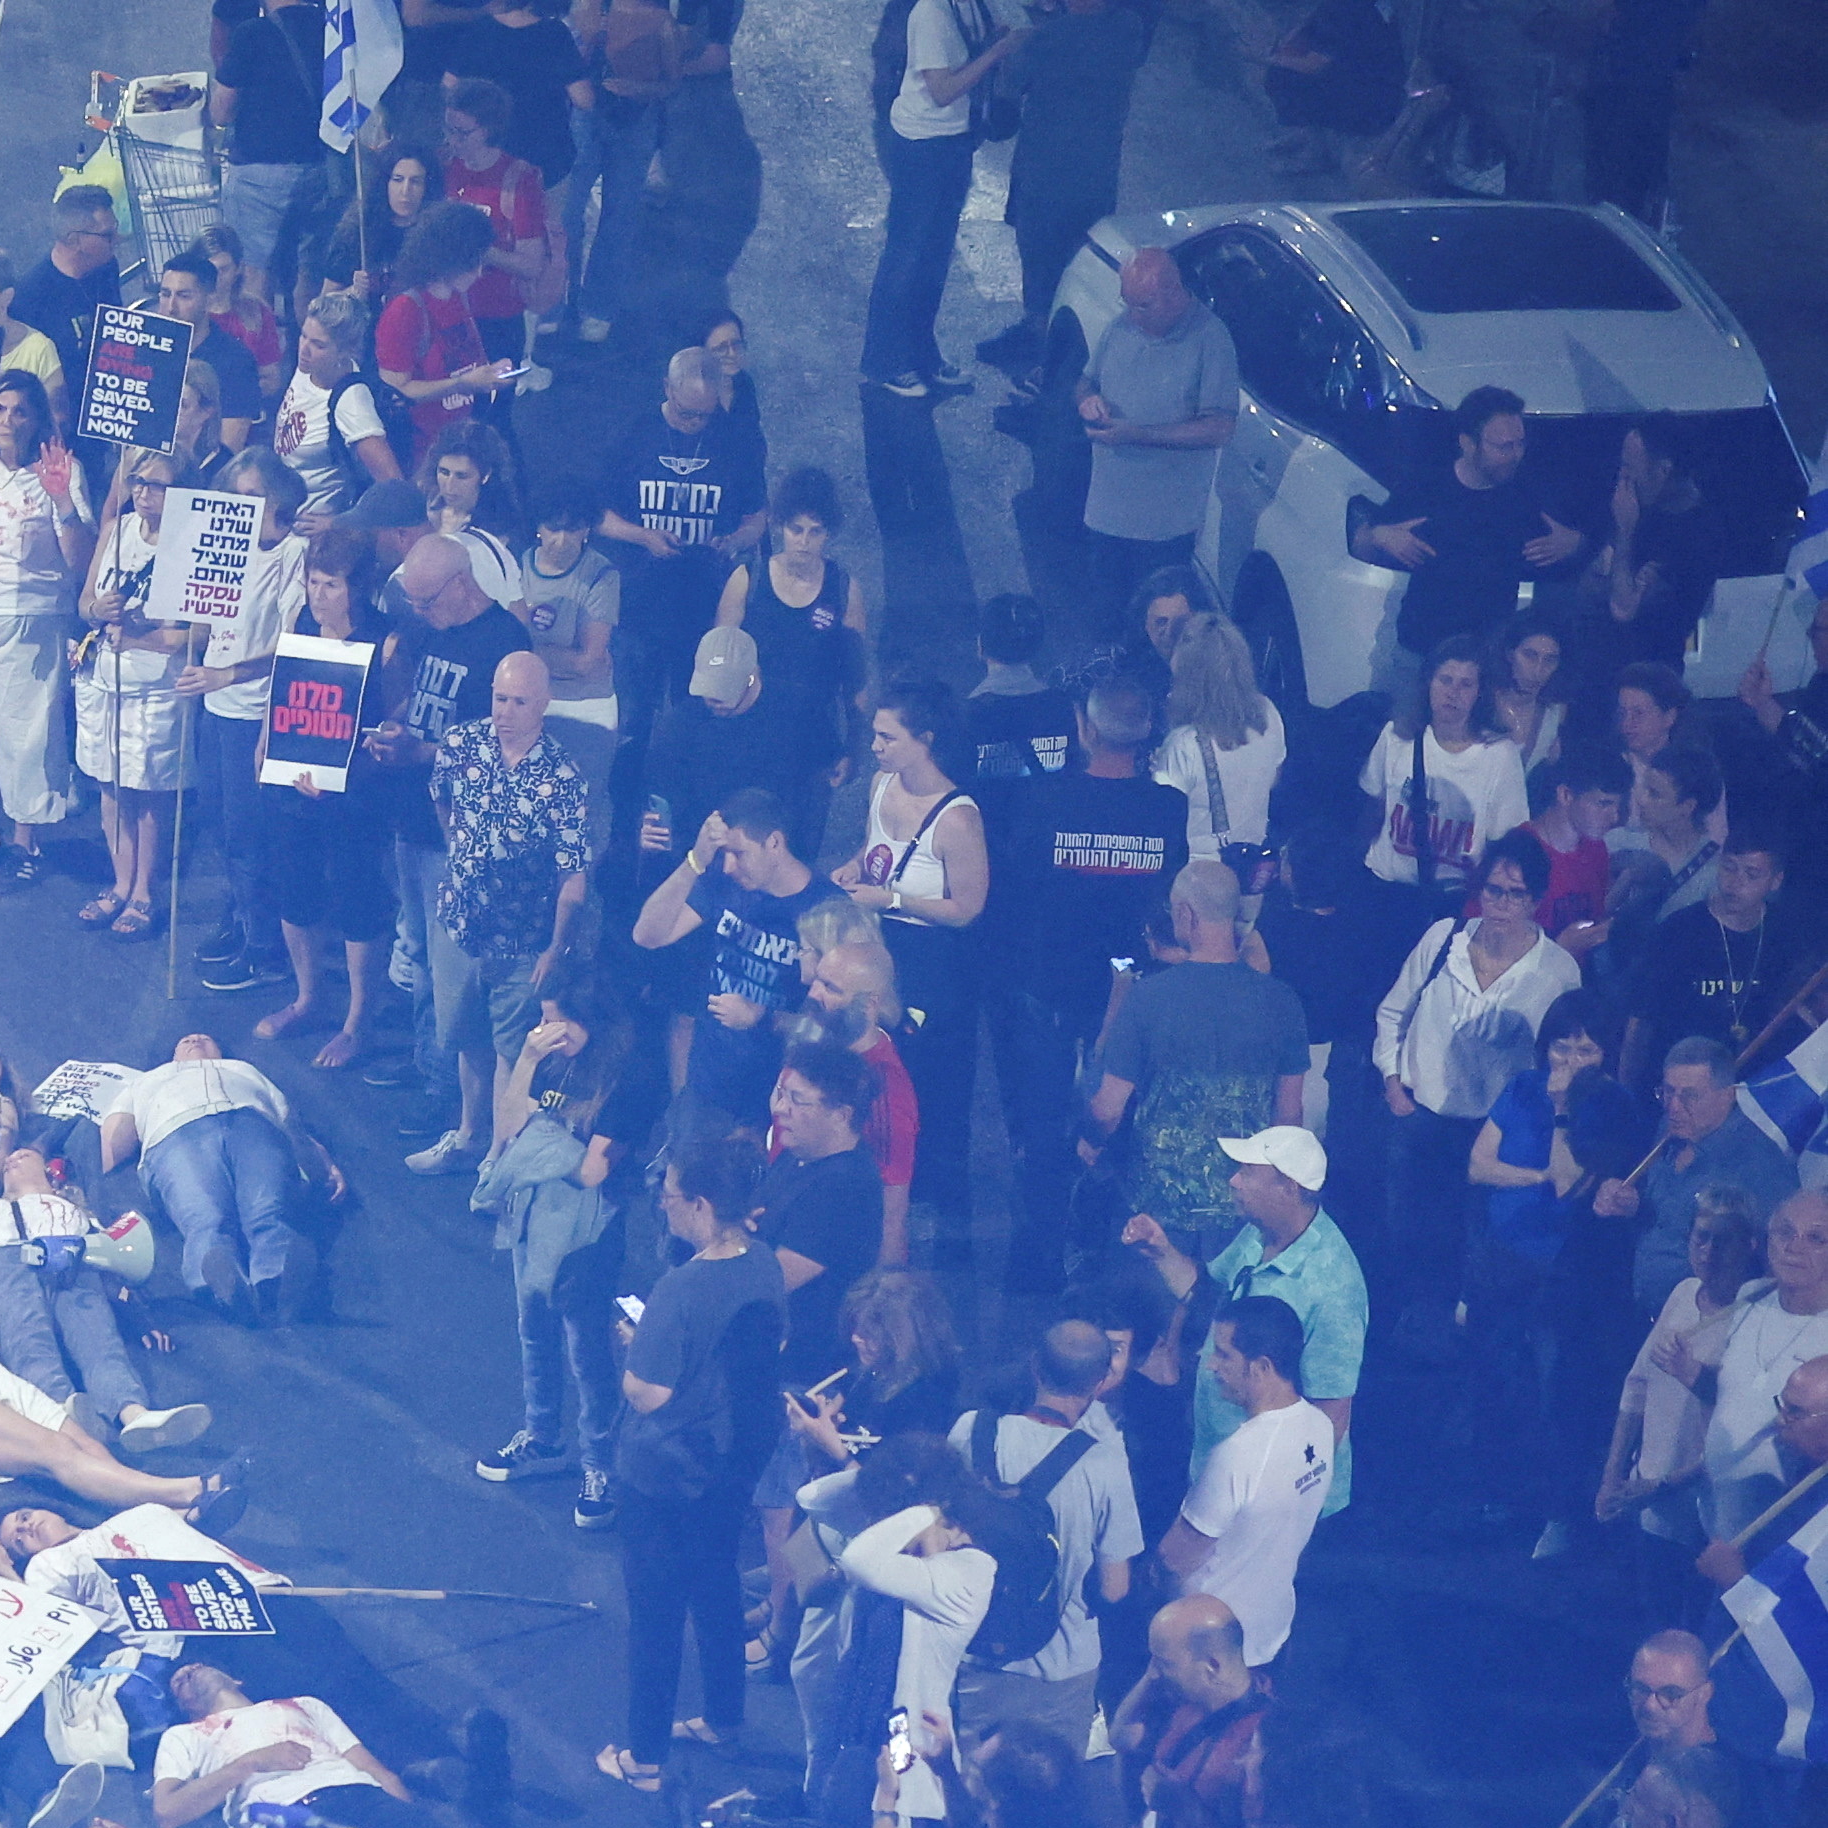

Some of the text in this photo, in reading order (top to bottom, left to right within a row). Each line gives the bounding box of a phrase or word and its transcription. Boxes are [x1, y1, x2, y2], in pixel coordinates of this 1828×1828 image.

[105, 310, 144, 331] OUR
[102, 325, 174, 353] PEOPLE
[95, 372, 148, 396] TO BE
[92, 388, 154, 413] SAVED.
[89, 403, 138, 426] DEAL
[87, 417, 134, 441] NOW.
[191, 497, 256, 519] האחים
[639, 480, 722, 515] בחירות
[209, 517, 253, 535] שלנו
[199, 533, 250, 552] מתים
[191, 547, 247, 568] שנציל
[189, 566, 245, 586] אותם.
[185, 582, 242, 602] עסקה
[179, 599, 239, 619] עכשיו.
[288, 680, 343, 711] כולנו
[273, 705, 354, 740] חטופים
[51, 1078, 100, 1087] DYING
[63, 1064, 123, 1080] SISTERS
[130, 1596, 153, 1630] OUR
[131, 1574, 167, 1629] SISTERS
[184, 1584, 214, 1629] TO BE
[217, 1591, 243, 1630] STOP
[235, 1598, 257, 1629] THE
